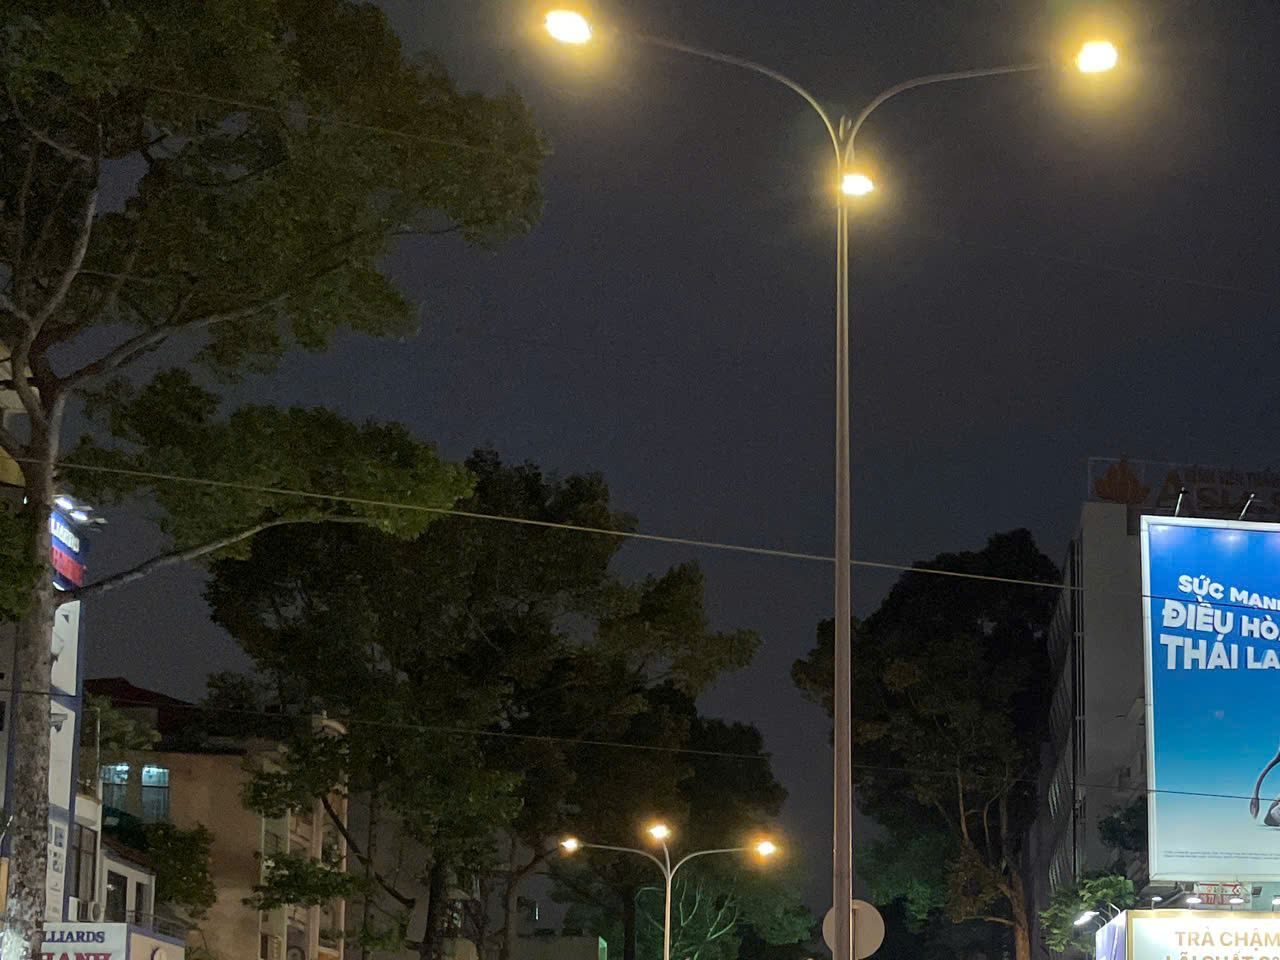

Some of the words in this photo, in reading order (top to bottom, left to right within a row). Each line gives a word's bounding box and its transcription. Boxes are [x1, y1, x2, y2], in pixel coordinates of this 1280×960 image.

[1178, 574, 1225, 600] SỨC
[1162, 596, 1234, 635] ĐIỀU
[1160, 633, 1239, 670] THÁI
[43, 931, 106, 943] LLIARDS
[1175, 926, 1215, 947] TRẢ
[1220, 928, 1280, 951] CHẬM
